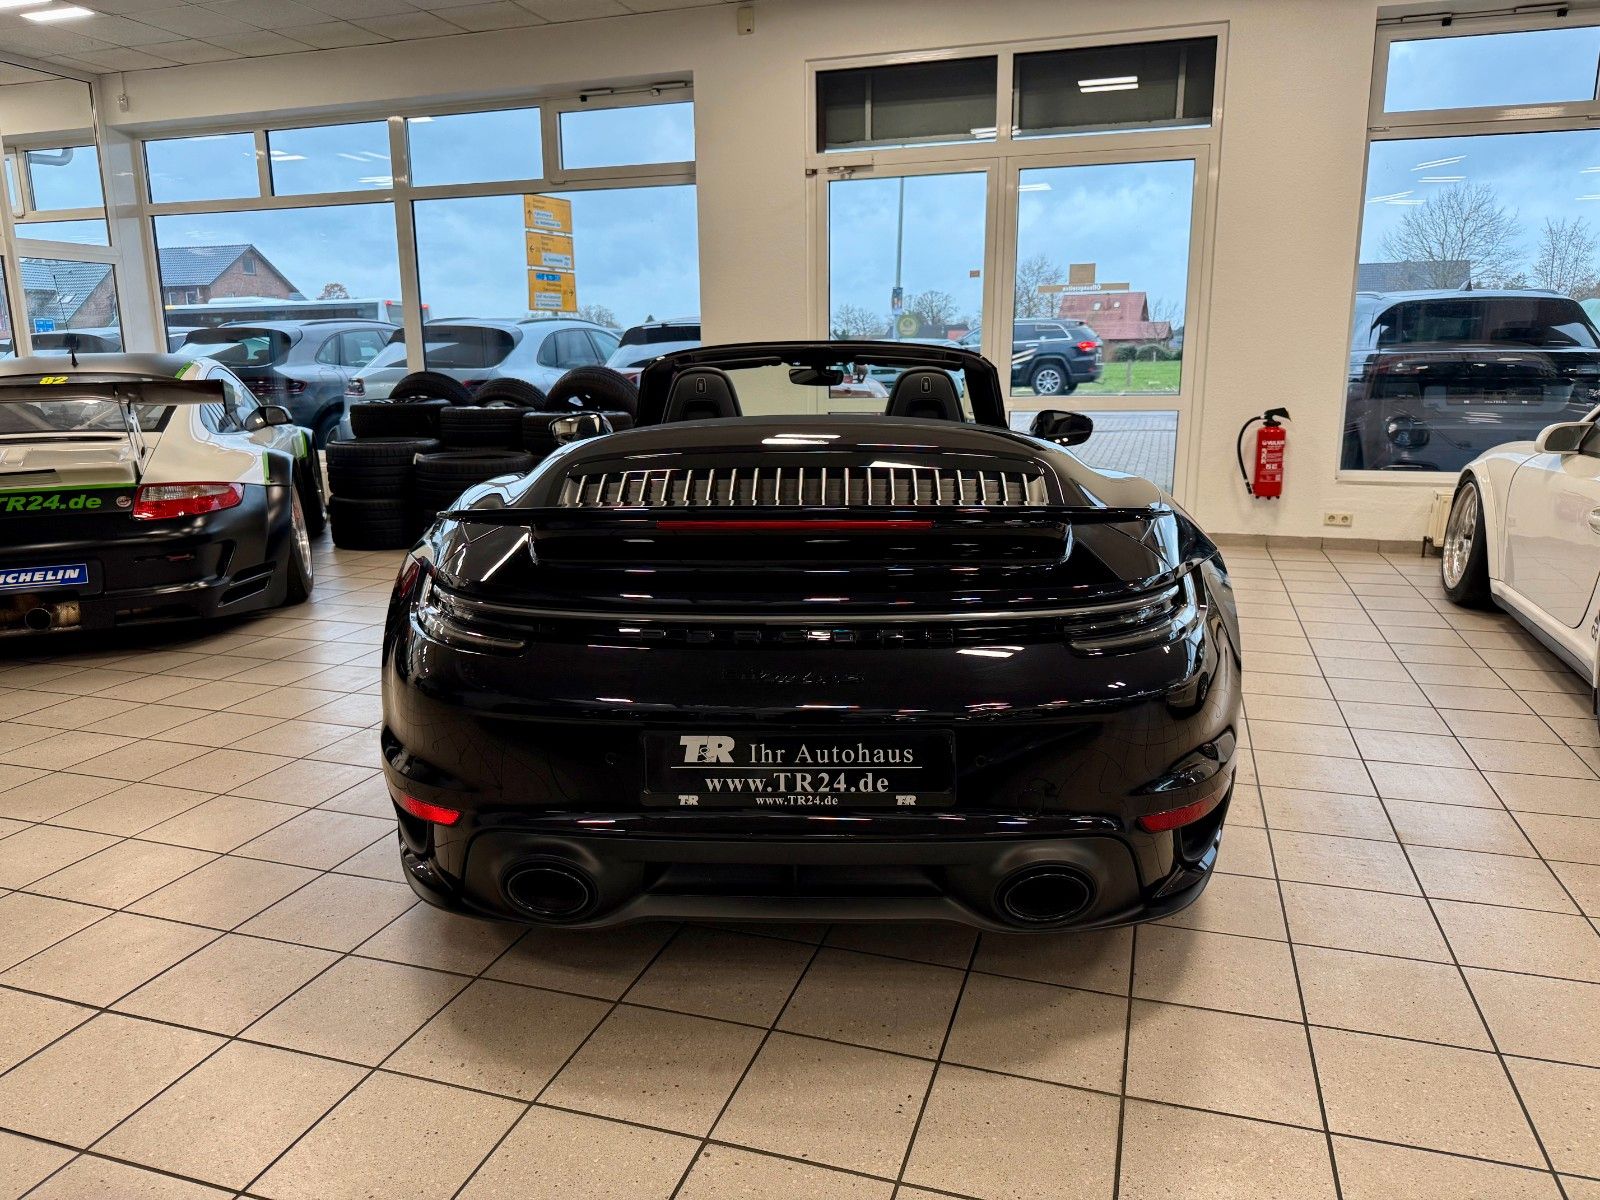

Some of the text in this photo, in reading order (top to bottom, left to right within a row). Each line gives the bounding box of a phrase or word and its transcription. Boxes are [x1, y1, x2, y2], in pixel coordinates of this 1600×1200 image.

[0, 569, 80, 583] ICHELIN
[749, 743, 786, 763] Ihr
[795, 742, 914, 764] Autohaus
[705, 772, 889, 793] www.TR24.de
[756, 795, 839, 806] www.TR24.de
